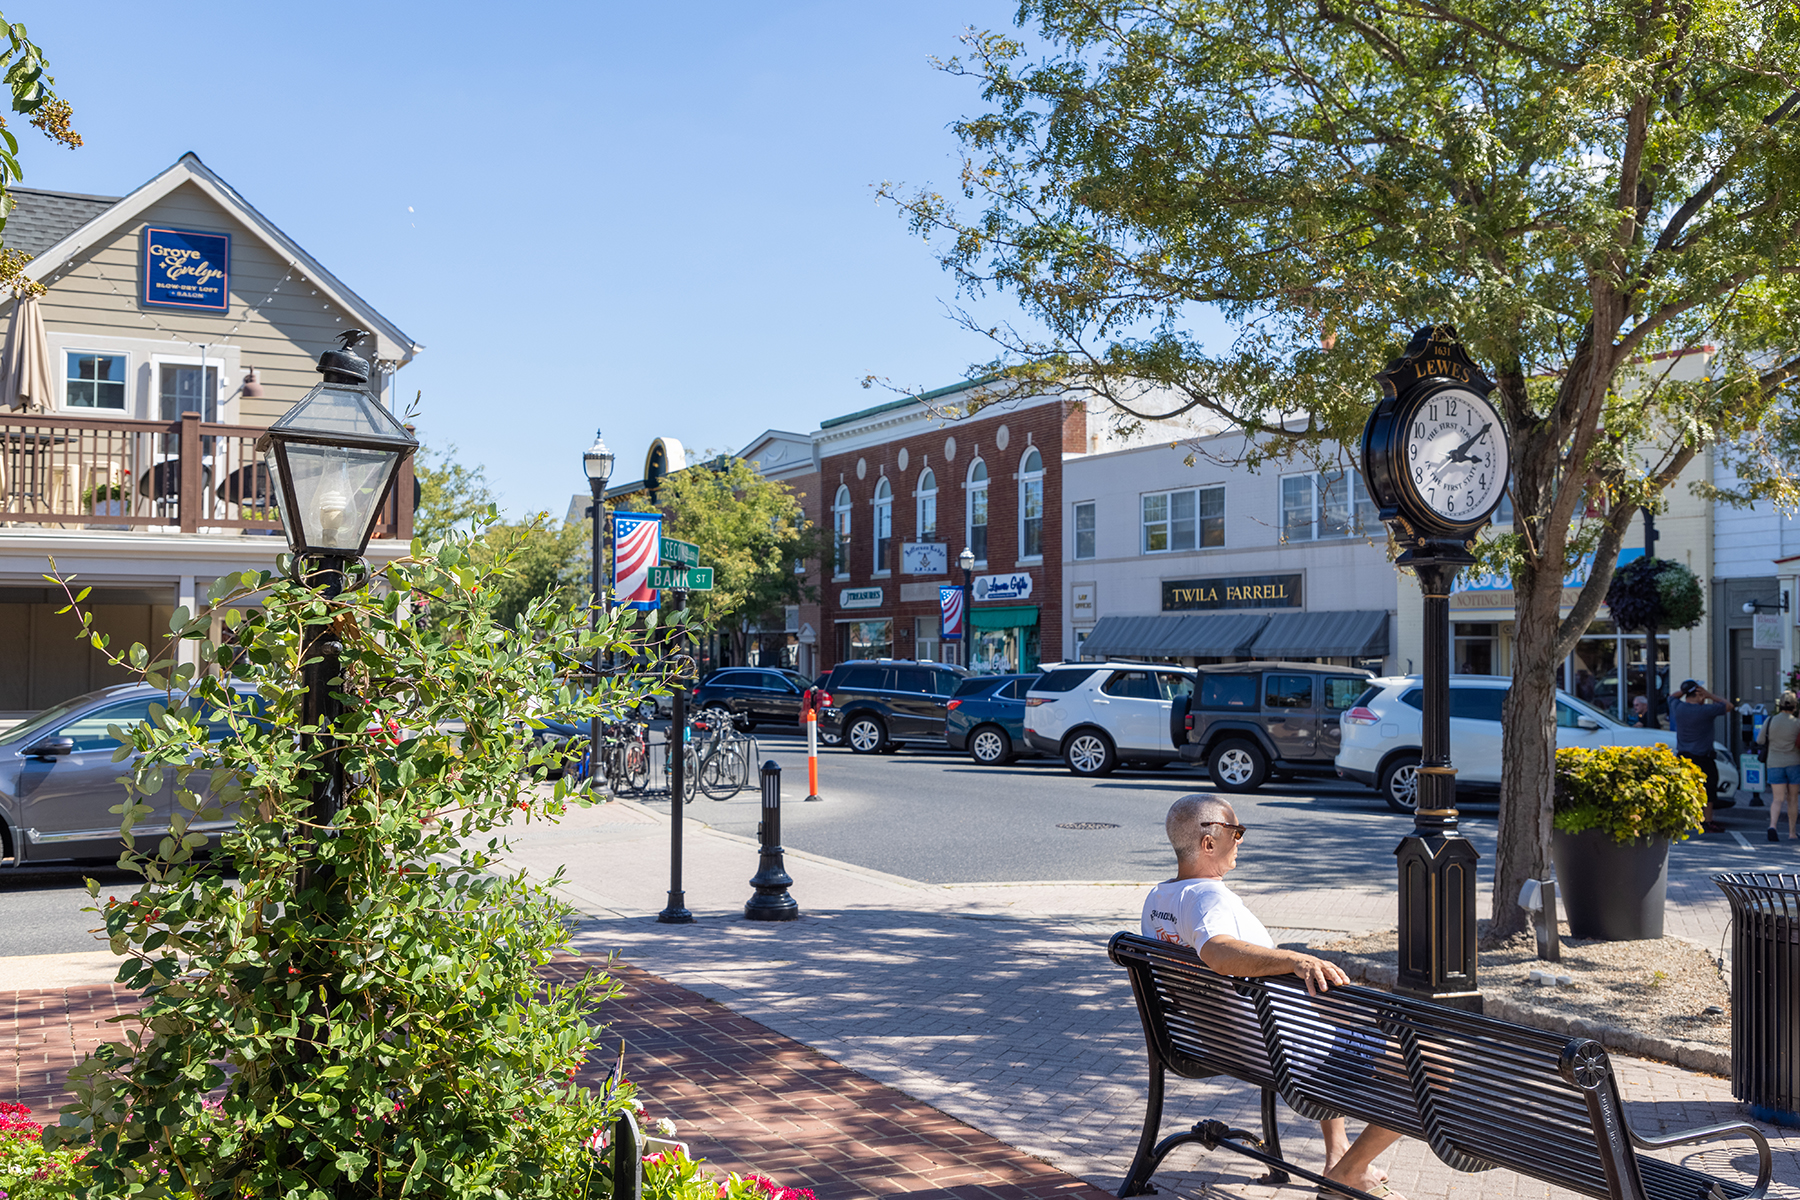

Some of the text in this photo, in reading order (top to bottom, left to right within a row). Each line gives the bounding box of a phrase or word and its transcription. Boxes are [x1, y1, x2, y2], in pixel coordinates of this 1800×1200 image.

[150, 244, 201, 259] Grove
[165, 256, 224, 285] Evelyn
[1434, 346, 1451, 356] 1631
[1414, 359, 1471, 383] LEWES
[1429, 405, 1438, 421] 11
[1445, 400, 1457, 417] 12
[1467, 409, 1472, 426] 1
[1414, 422, 1425, 439] 10
[1427, 422, 1472, 442] THE FIRST TOW
[1410, 444, 1417, 460] 9
[1485, 452, 1491, 468] 3
[1415, 467, 1423, 484] 8
[1479, 473, 1486, 490] 4
[1443, 483, 1462, 491] FIRST
[1427, 488, 1435, 505] 7
[1447, 495, 1454, 512] 6
[1466, 490, 1474, 507] 5
[654, 570, 705, 586] BANK ST
[1172, 584, 1289, 602] TWILA FARRELL
[1457, 593, 1515, 606] NOTTING HIL
